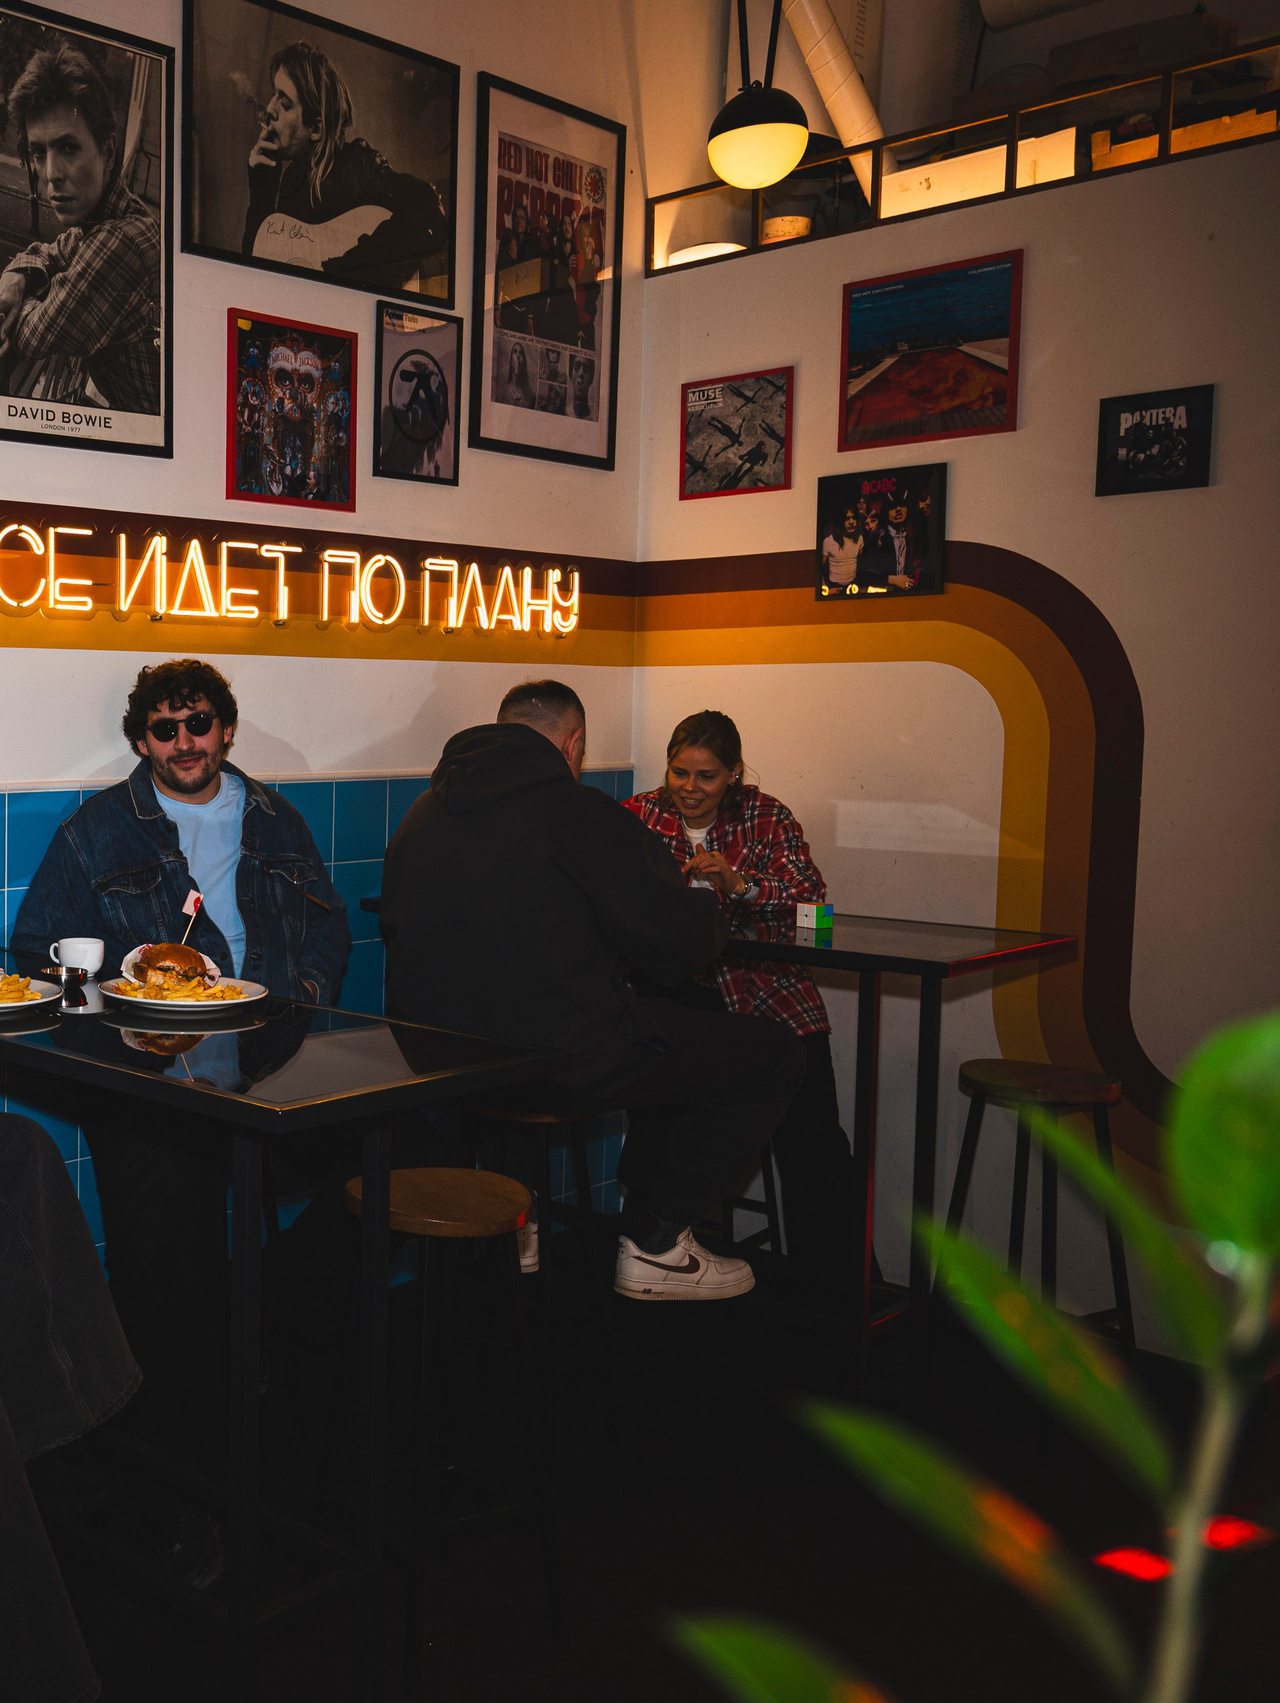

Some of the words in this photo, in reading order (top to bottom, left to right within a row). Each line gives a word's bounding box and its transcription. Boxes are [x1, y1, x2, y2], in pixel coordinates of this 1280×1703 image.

[498, 137, 522, 174] RED
[526, 147, 550, 184] HOT
[688, 388, 722, 402] MUSE
[7, 404, 56, 422] DAVID
[61, 411, 112, 429] BOWIE
[41, 423, 65, 431] LONDON
[1120, 405, 1187, 436] PANTERA
[119, 533, 302, 620] ИДЕТ
[322, 550, 405, 625] ПО
[422, 558, 579, 632] ПЛАНУ
